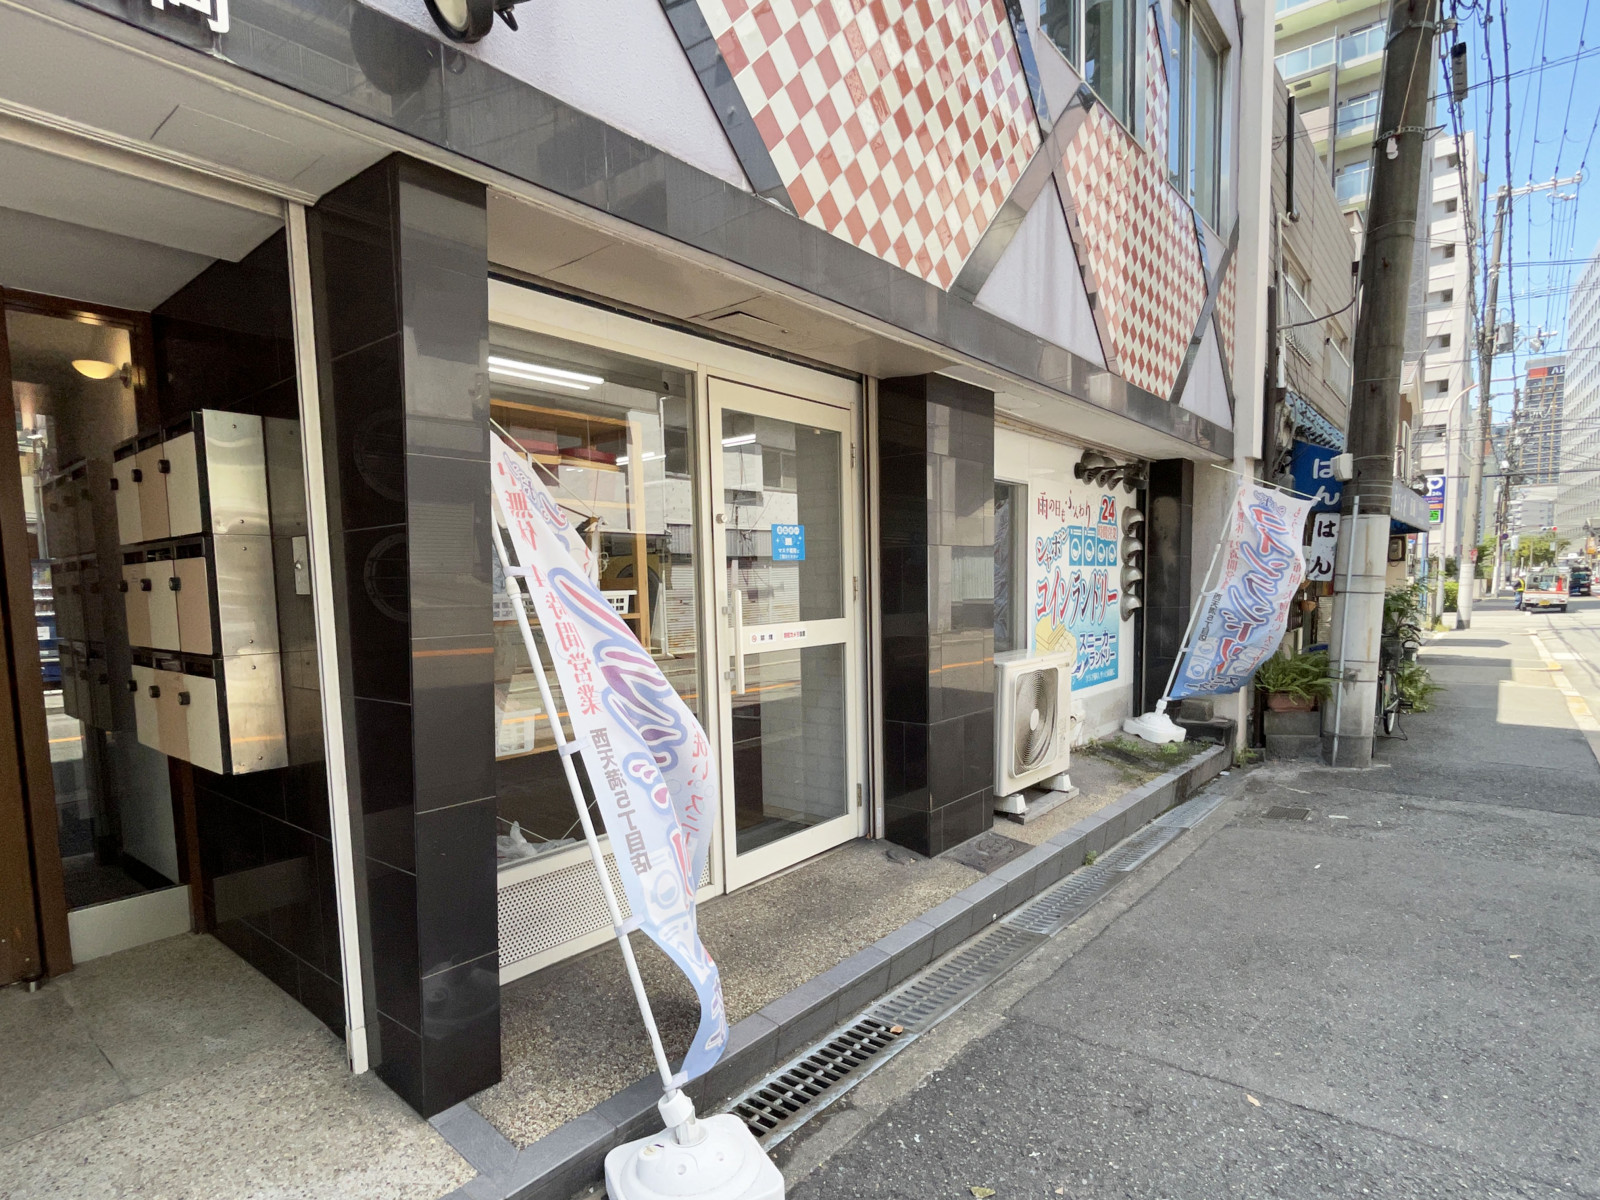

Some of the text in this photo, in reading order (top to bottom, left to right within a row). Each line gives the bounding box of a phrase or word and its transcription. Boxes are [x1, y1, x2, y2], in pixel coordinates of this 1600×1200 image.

[1101, 498, 1116, 523] 24
[1309, 520, 1337, 576] はん
[1036, 567, 1119, 629] コインランドリー
[1079, 630, 1117, 652] スニーカー
[1089, 649, 1116, 667] ランドリー
